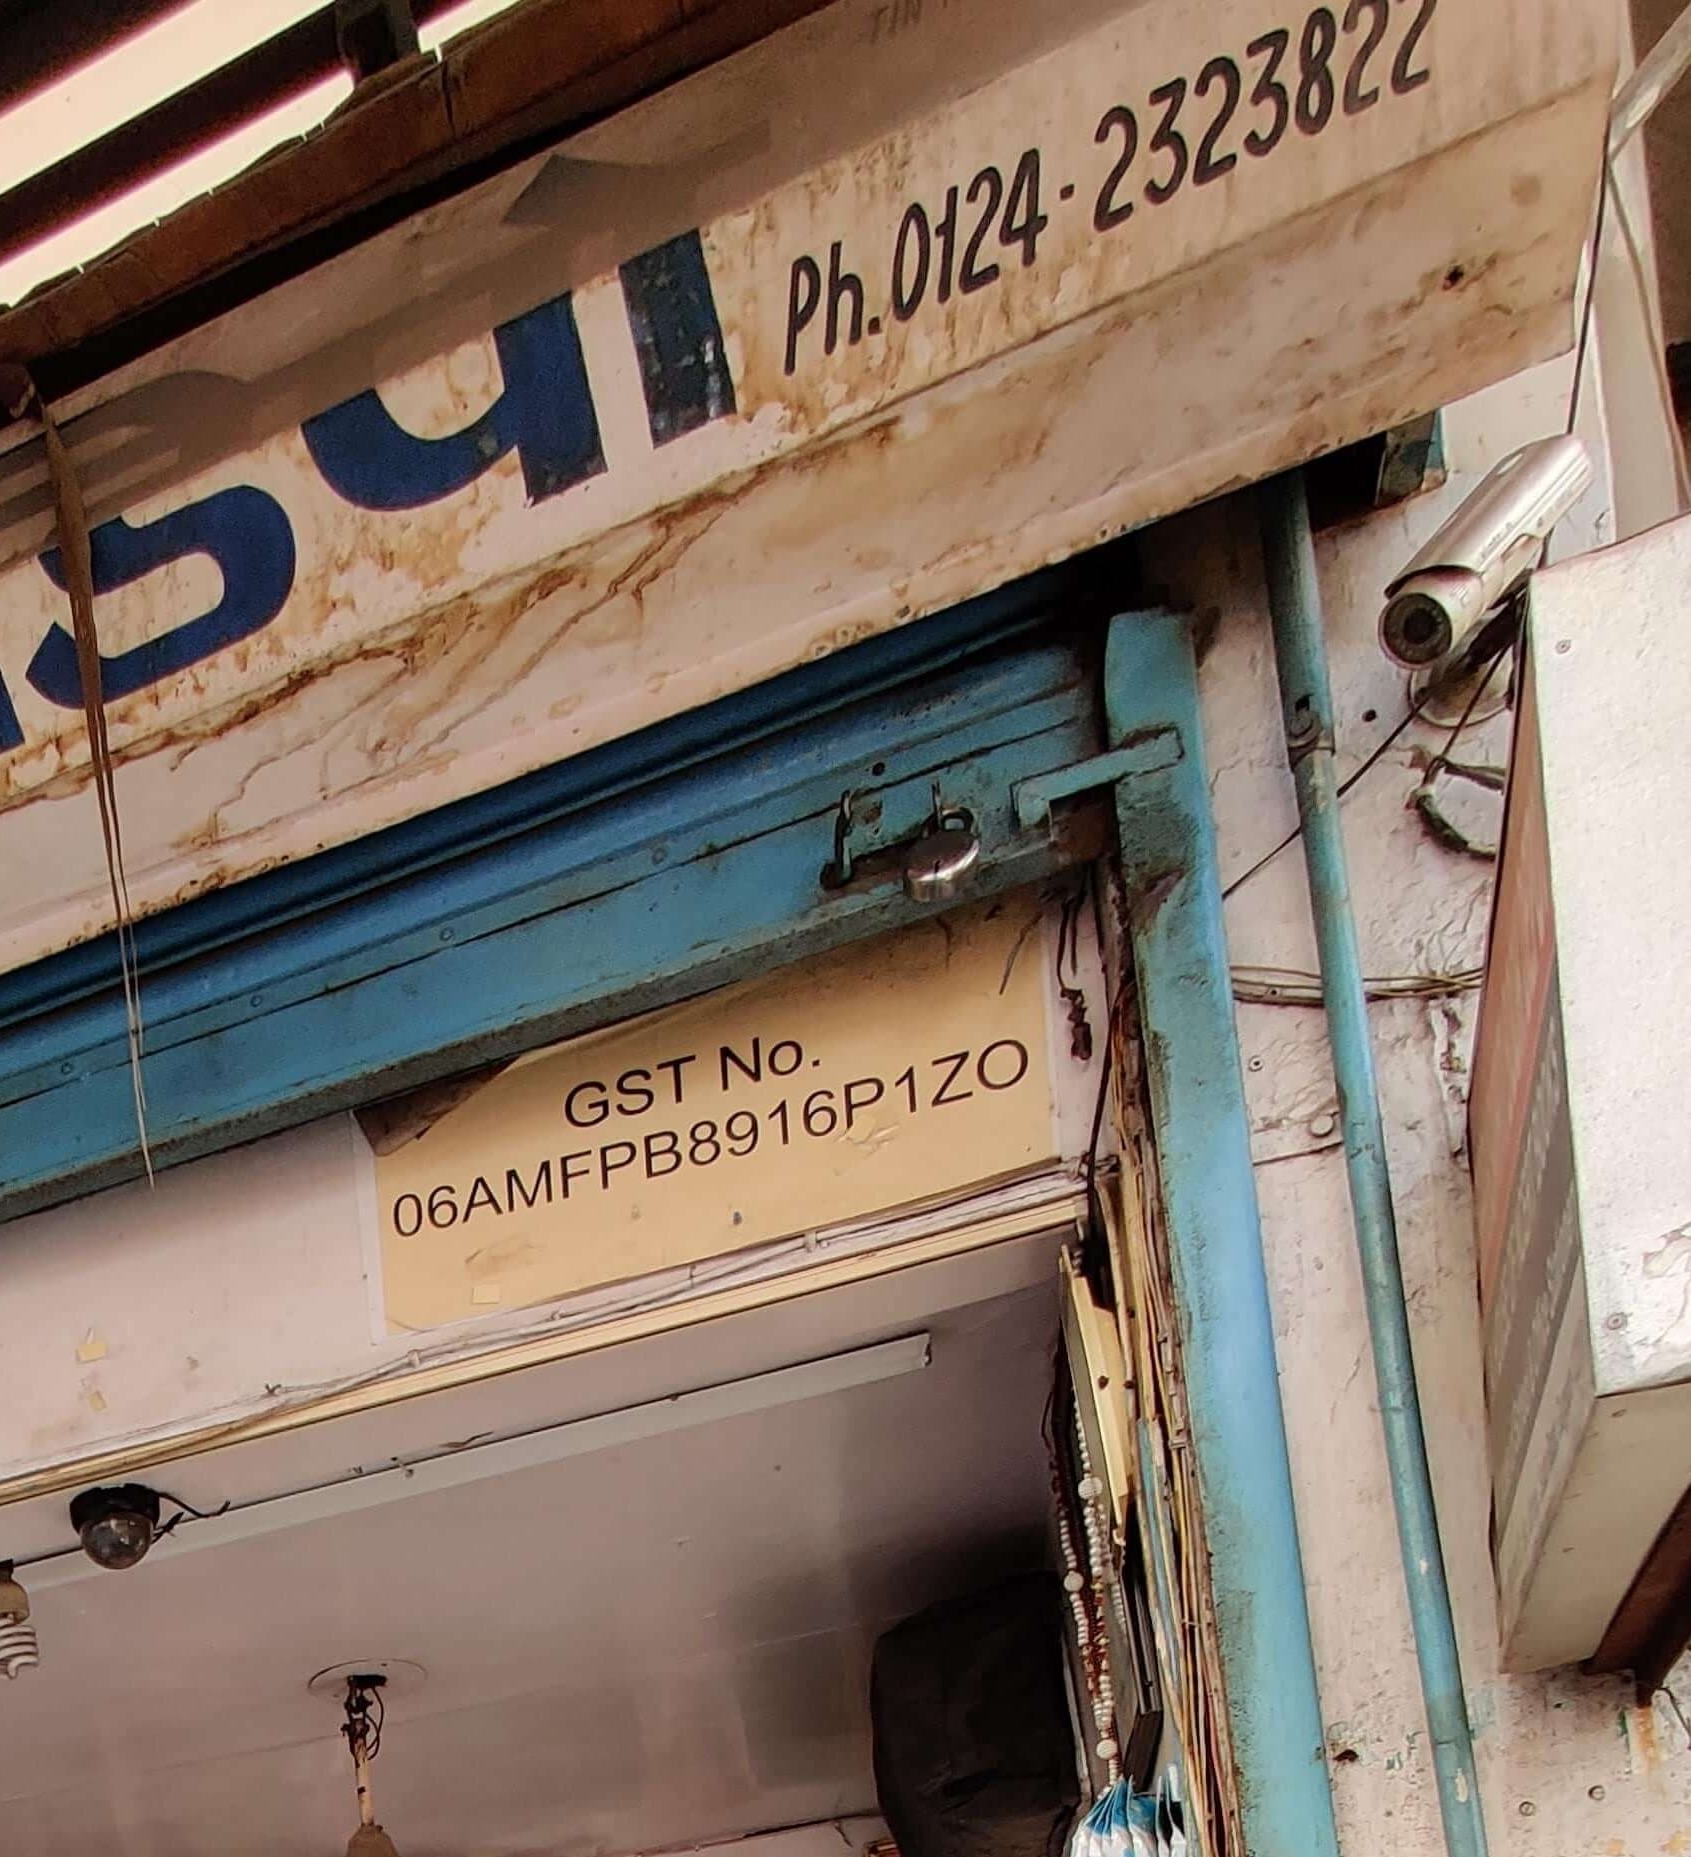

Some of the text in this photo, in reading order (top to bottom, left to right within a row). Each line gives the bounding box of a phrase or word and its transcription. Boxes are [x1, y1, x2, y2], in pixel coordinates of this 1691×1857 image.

[392, 1038, 1030, 1237] 06AMFPB8916P1ZO
[564, 1036, 822, 1129] GST No.
